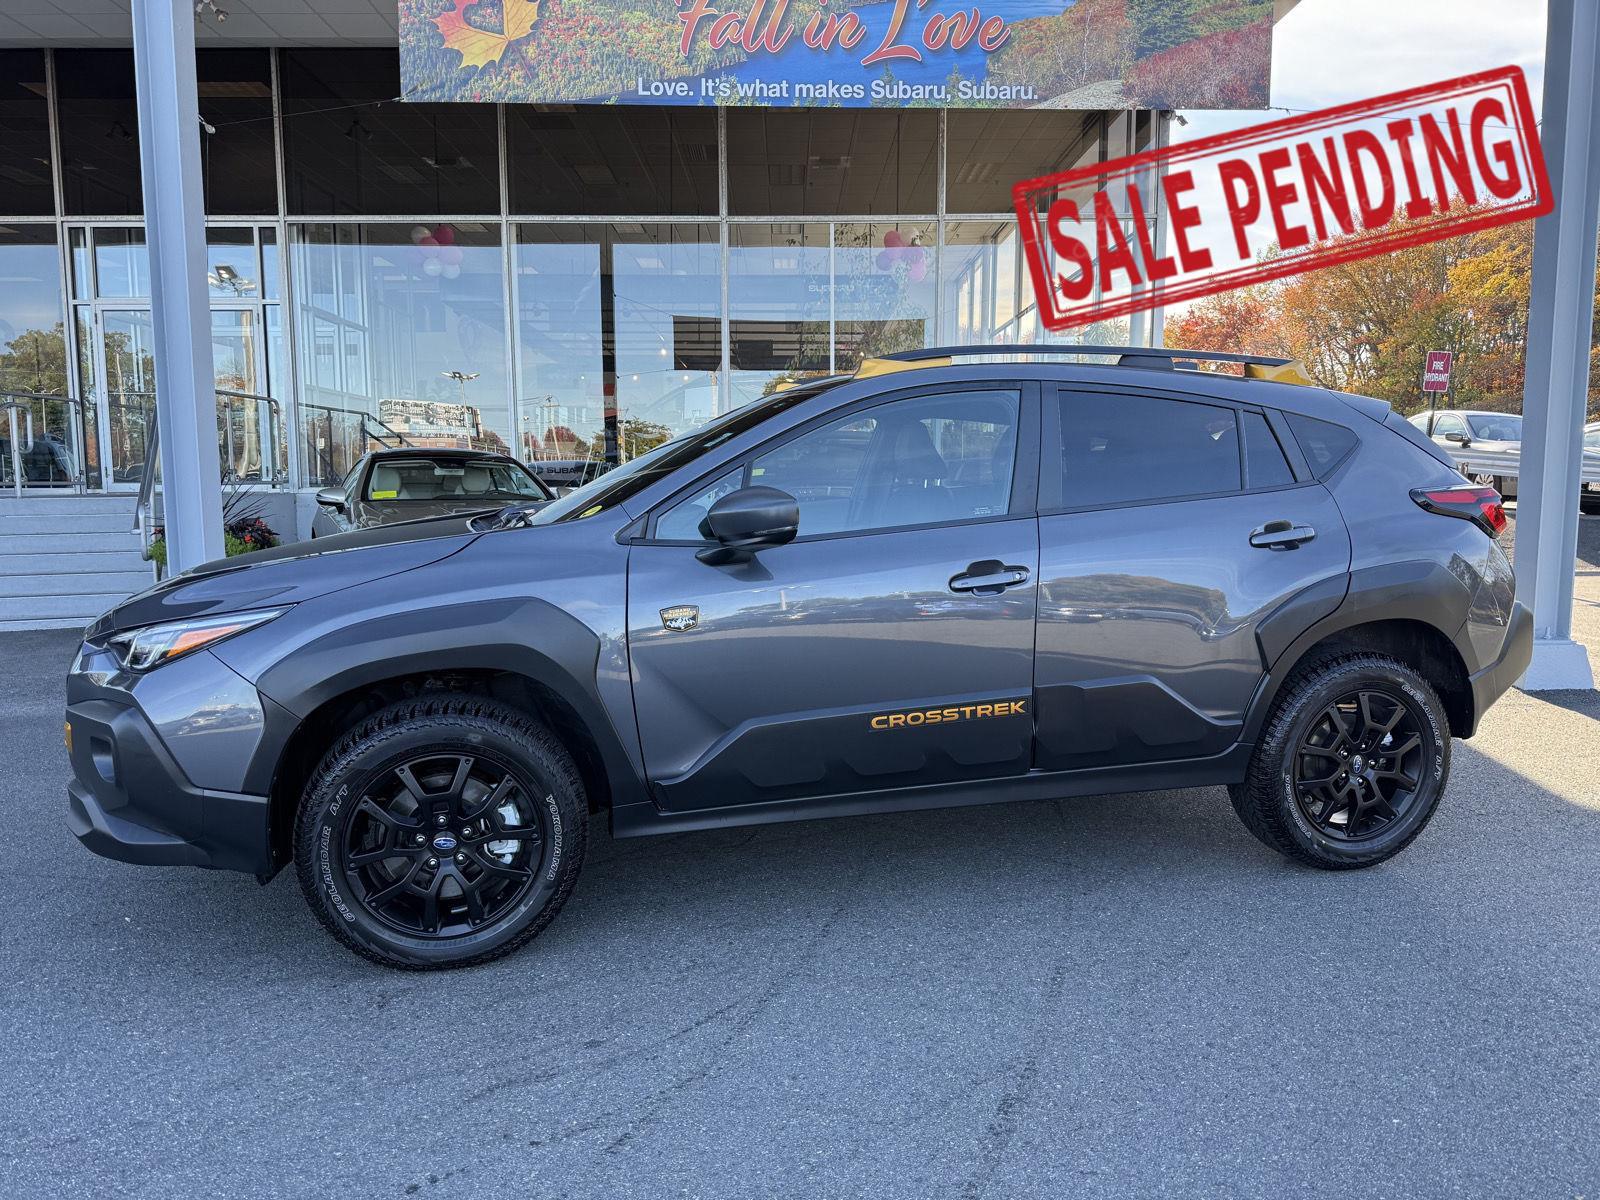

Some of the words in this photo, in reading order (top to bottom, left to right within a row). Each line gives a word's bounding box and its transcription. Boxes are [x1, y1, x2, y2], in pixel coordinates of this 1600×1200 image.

[674, 0, 794, 57] Fall
[803, 0, 867, 51] in
[861, 0, 1011, 65] Love
[637, 77, 694, 97] Love.
[737, 79, 789, 98] what
[794, 80, 865, 98] makes
[871, 80, 951, 102] Subaru,
[958, 81, 1038, 100] Subaru.
[546, 466, 579, 474] SUBA
[870, 700, 1026, 729] CROSSTREK
[329, 783, 349, 816] A/T
[545, 793, 563, 881] YOKOHAMA
[320, 825, 356, 922] GEOLANDAR
